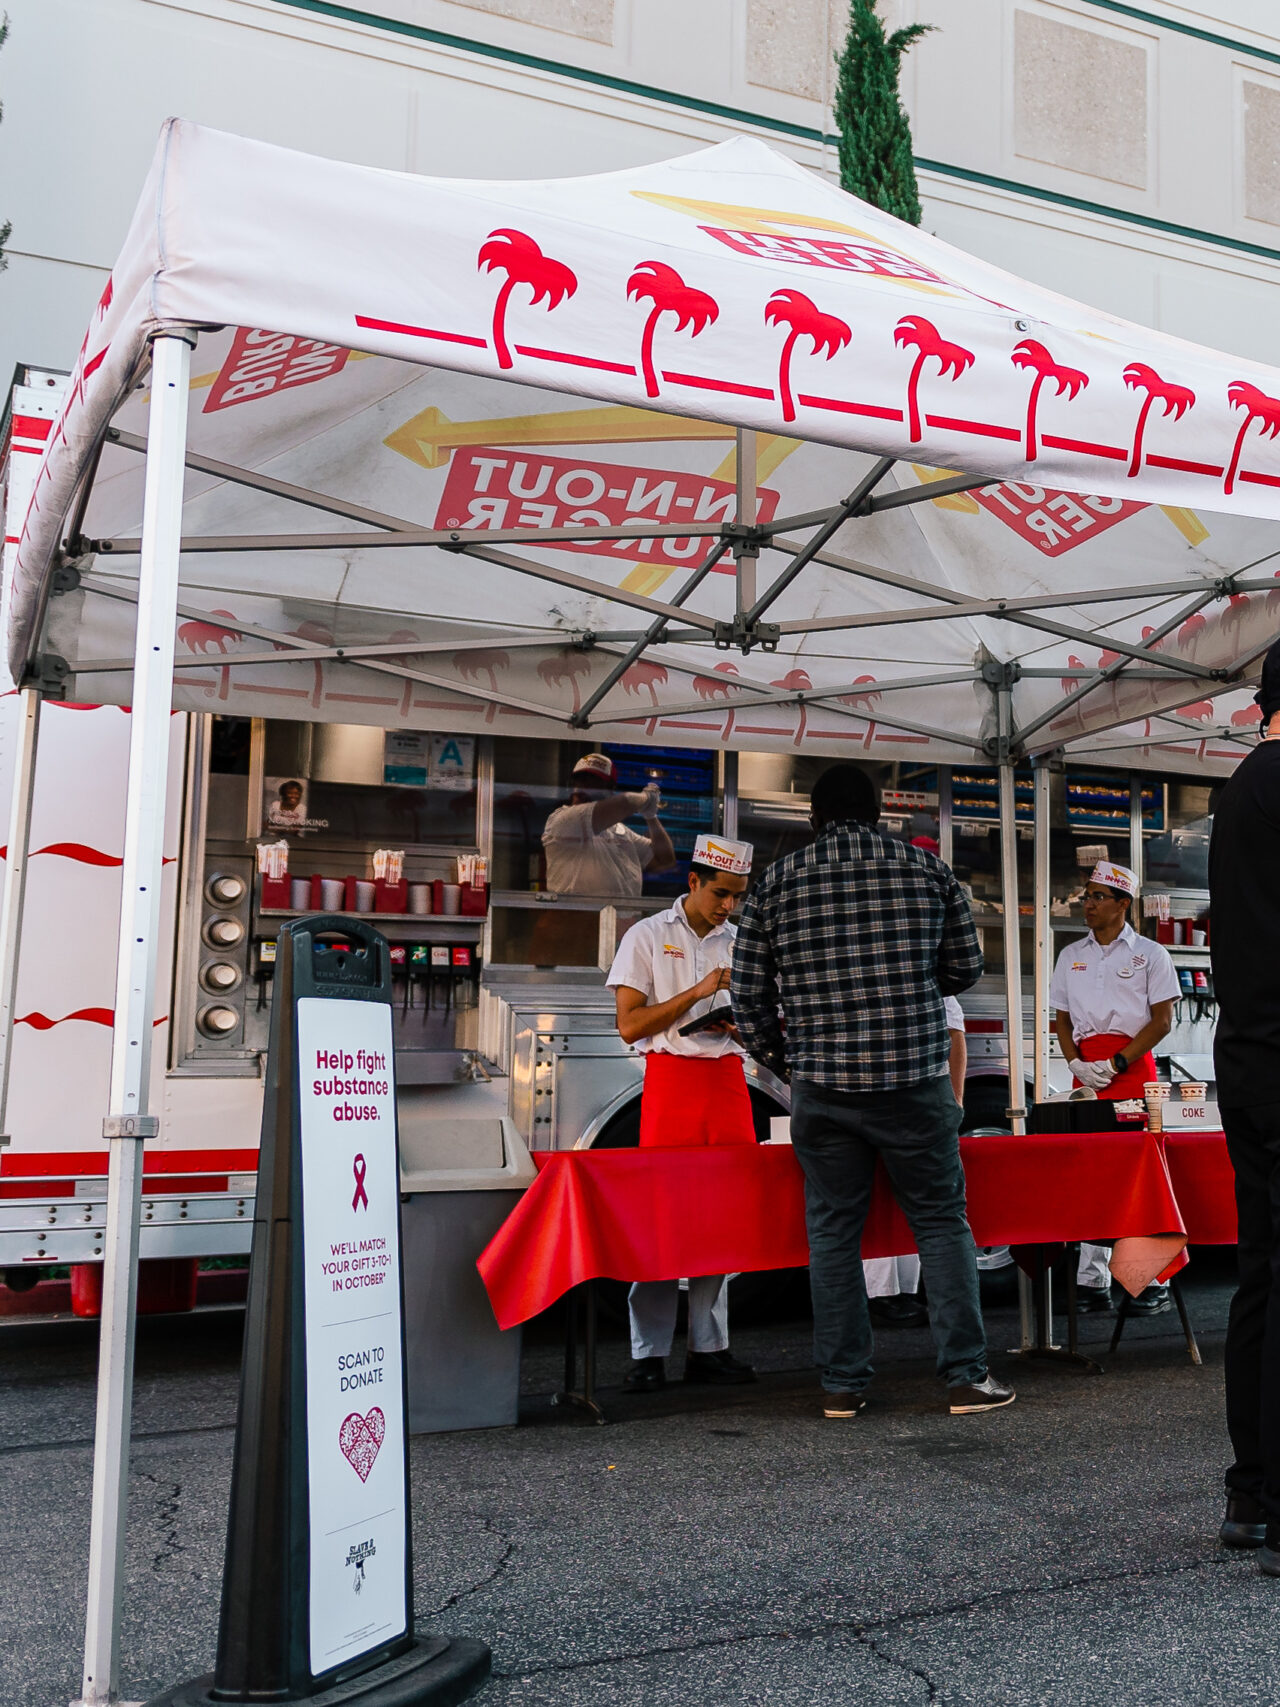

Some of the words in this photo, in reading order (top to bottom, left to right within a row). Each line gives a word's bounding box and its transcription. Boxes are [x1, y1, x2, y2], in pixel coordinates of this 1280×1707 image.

[438, 739, 463, 766] A
[316, 1049, 354, 1074] Help
[356, 1049, 386, 1075] fight
[313, 1075, 388, 1096] substance
[333, 1101, 381, 1122] abuse.
[1182, 1107, 1205, 1118] COKE
[330, 1241, 358, 1256] WE'LL
[359, 1237, 386, 1252] MATCH
[321, 1260, 350, 1275] YOUR
[351, 1257, 370, 1271] GIFT
[371, 1254, 391, 1268] 3-TO-1
[332, 1279, 343, 1292] IN
[338, 1350, 370, 1371] SCAN
[371, 1346, 384, 1363] TO
[340, 1367, 383, 1392] DONATE
[345, 1546, 376, 1567] NOTHING
